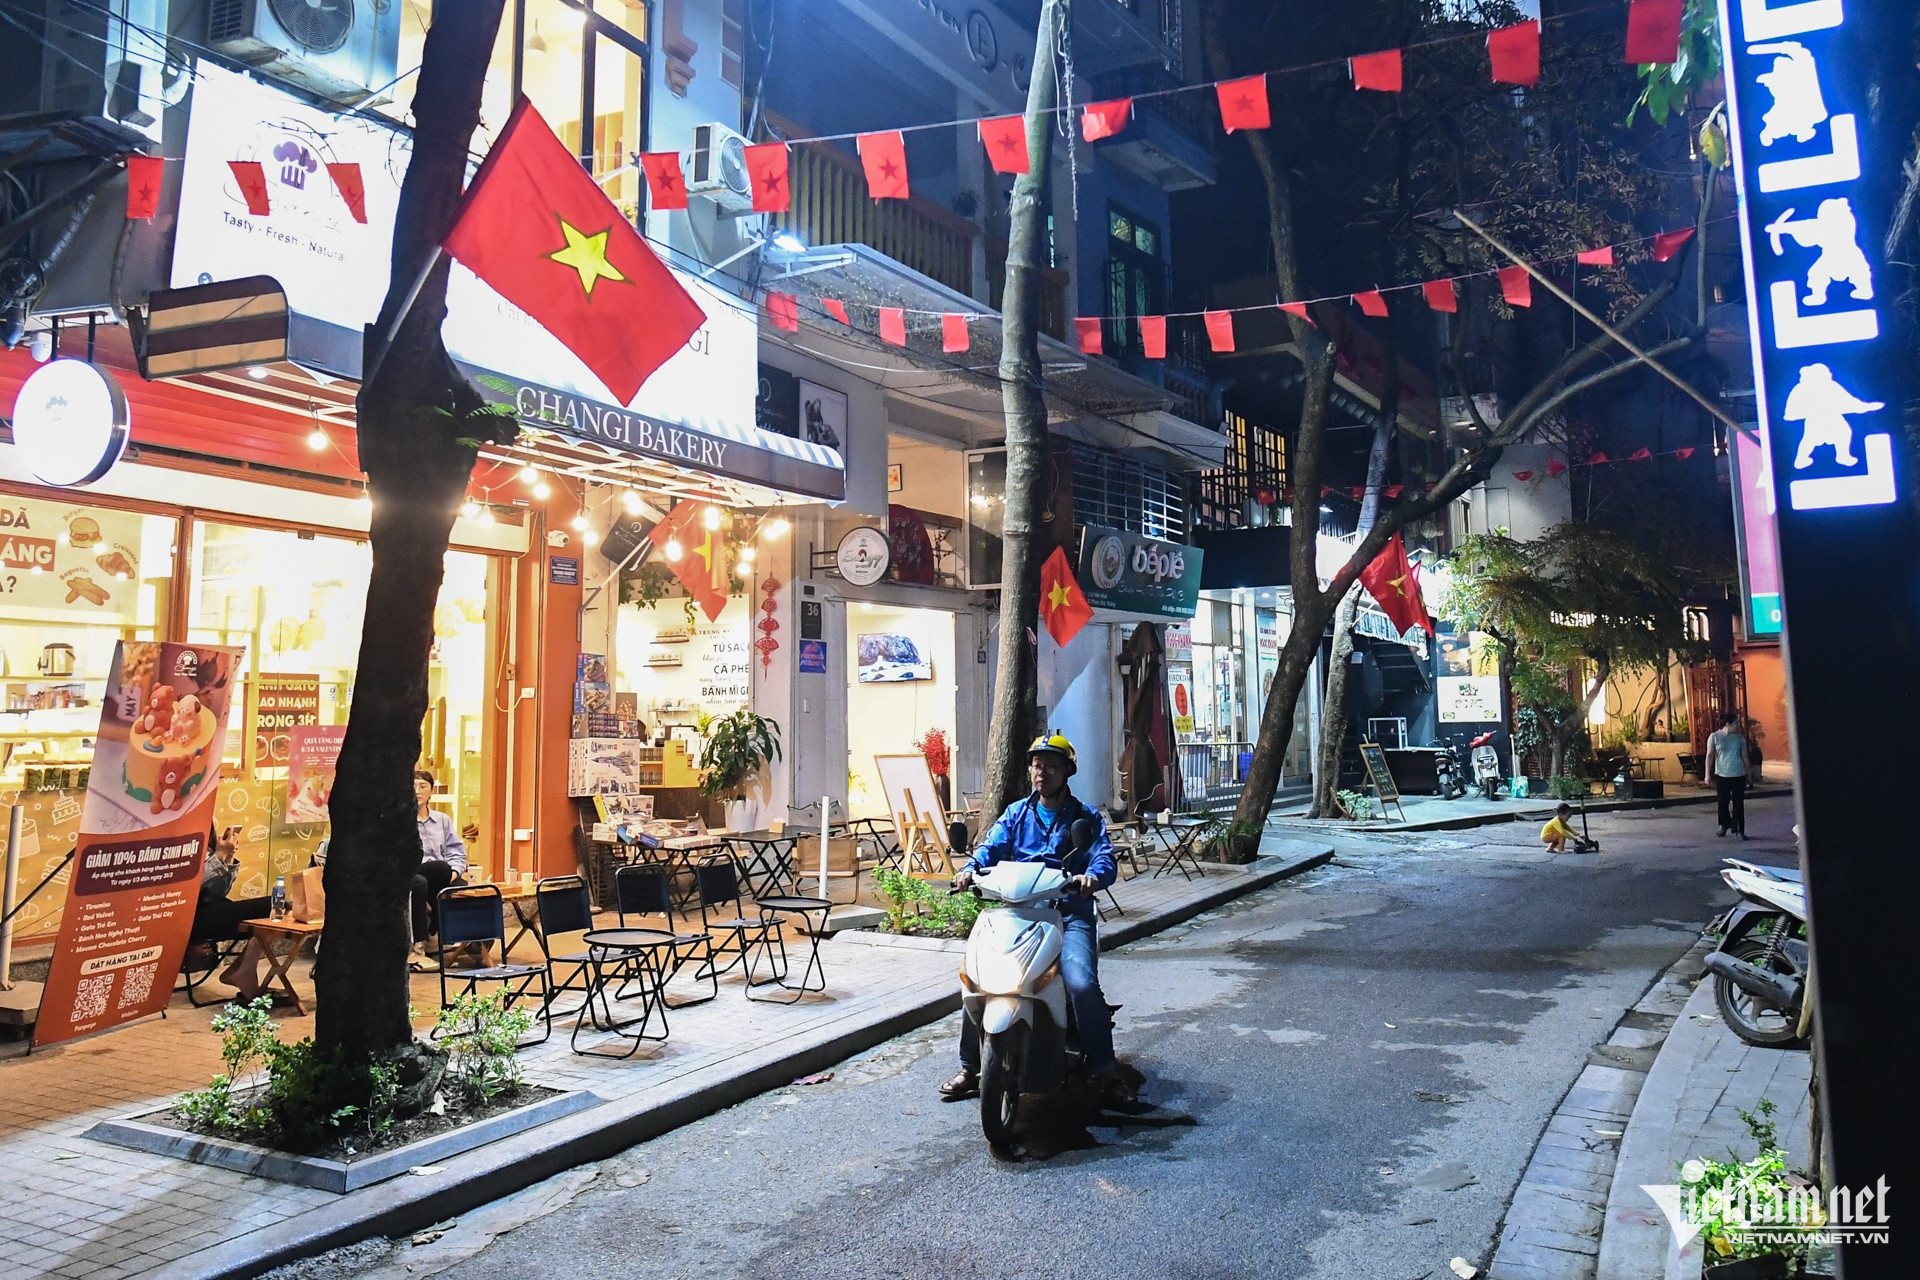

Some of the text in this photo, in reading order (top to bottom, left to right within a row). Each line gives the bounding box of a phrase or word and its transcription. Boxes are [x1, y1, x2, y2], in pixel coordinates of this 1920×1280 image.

[223, 211, 254, 233] Tasty
[266, 226, 298, 245] Fresh
[308, 241, 345, 262] Natura
[516, 386, 632, 444] CHANGI
[637, 419, 728, 469] BAKERY
[59, 566, 90, 581] Baguette
[807, 603, 819, 617] 36
[125, 695, 136, 717] MAY
[85, 849, 112, 869] GIẢM
[113, 850, 137, 867] 10%
[137, 845, 162, 863] BÁNH
[162, 844, 182, 860] SINH
